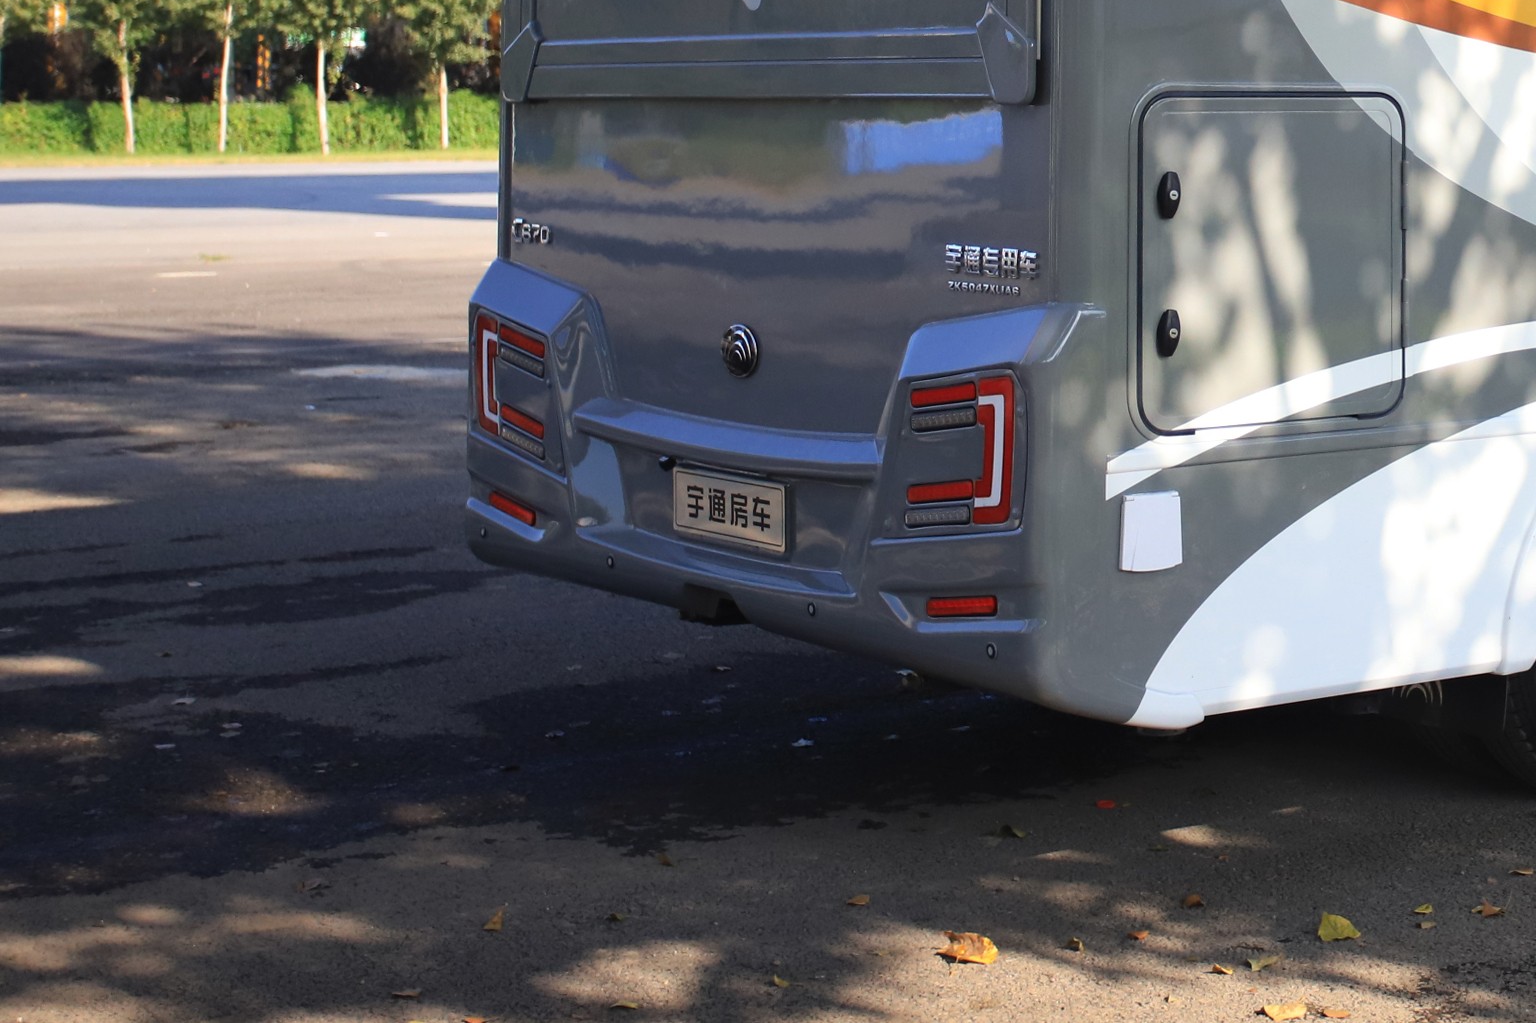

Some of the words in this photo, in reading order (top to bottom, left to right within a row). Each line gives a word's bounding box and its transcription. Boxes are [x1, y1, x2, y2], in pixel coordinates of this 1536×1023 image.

[945, 243, 1038, 280] 宇通专用车
[687, 484, 771, 532] 宇通房车
